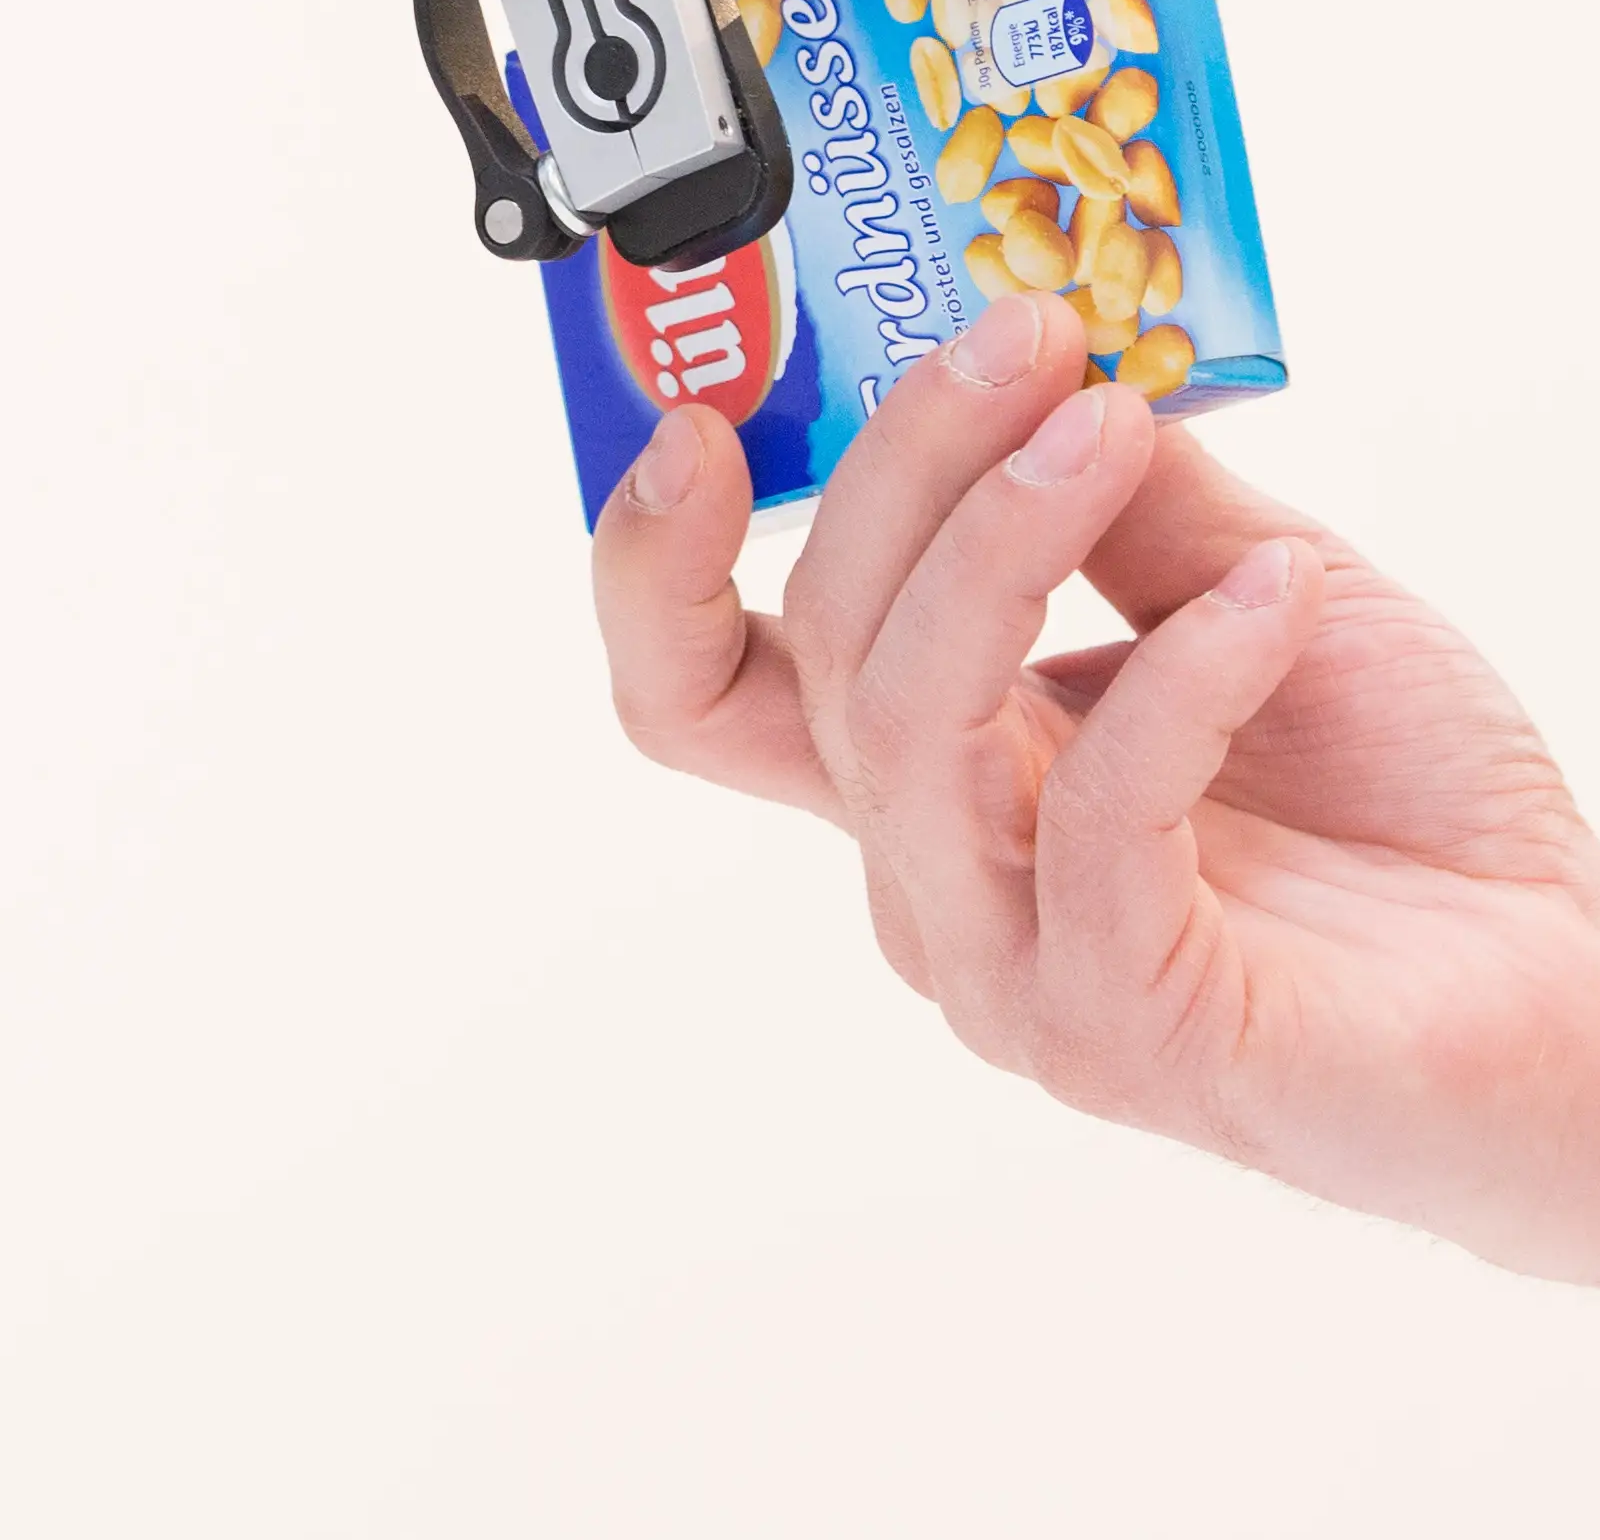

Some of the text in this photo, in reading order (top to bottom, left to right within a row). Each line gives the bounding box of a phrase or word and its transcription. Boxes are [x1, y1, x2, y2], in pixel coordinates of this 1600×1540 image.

[971, 21, 992, 90] 30g Portion
[1007, 22, 1026, 68] Energie
[1023, 19, 1045, 59] 773kJ
[1043, 6, 1066, 60] 187kcal
[880, 83, 971, 337] eröstet und gesalzen
